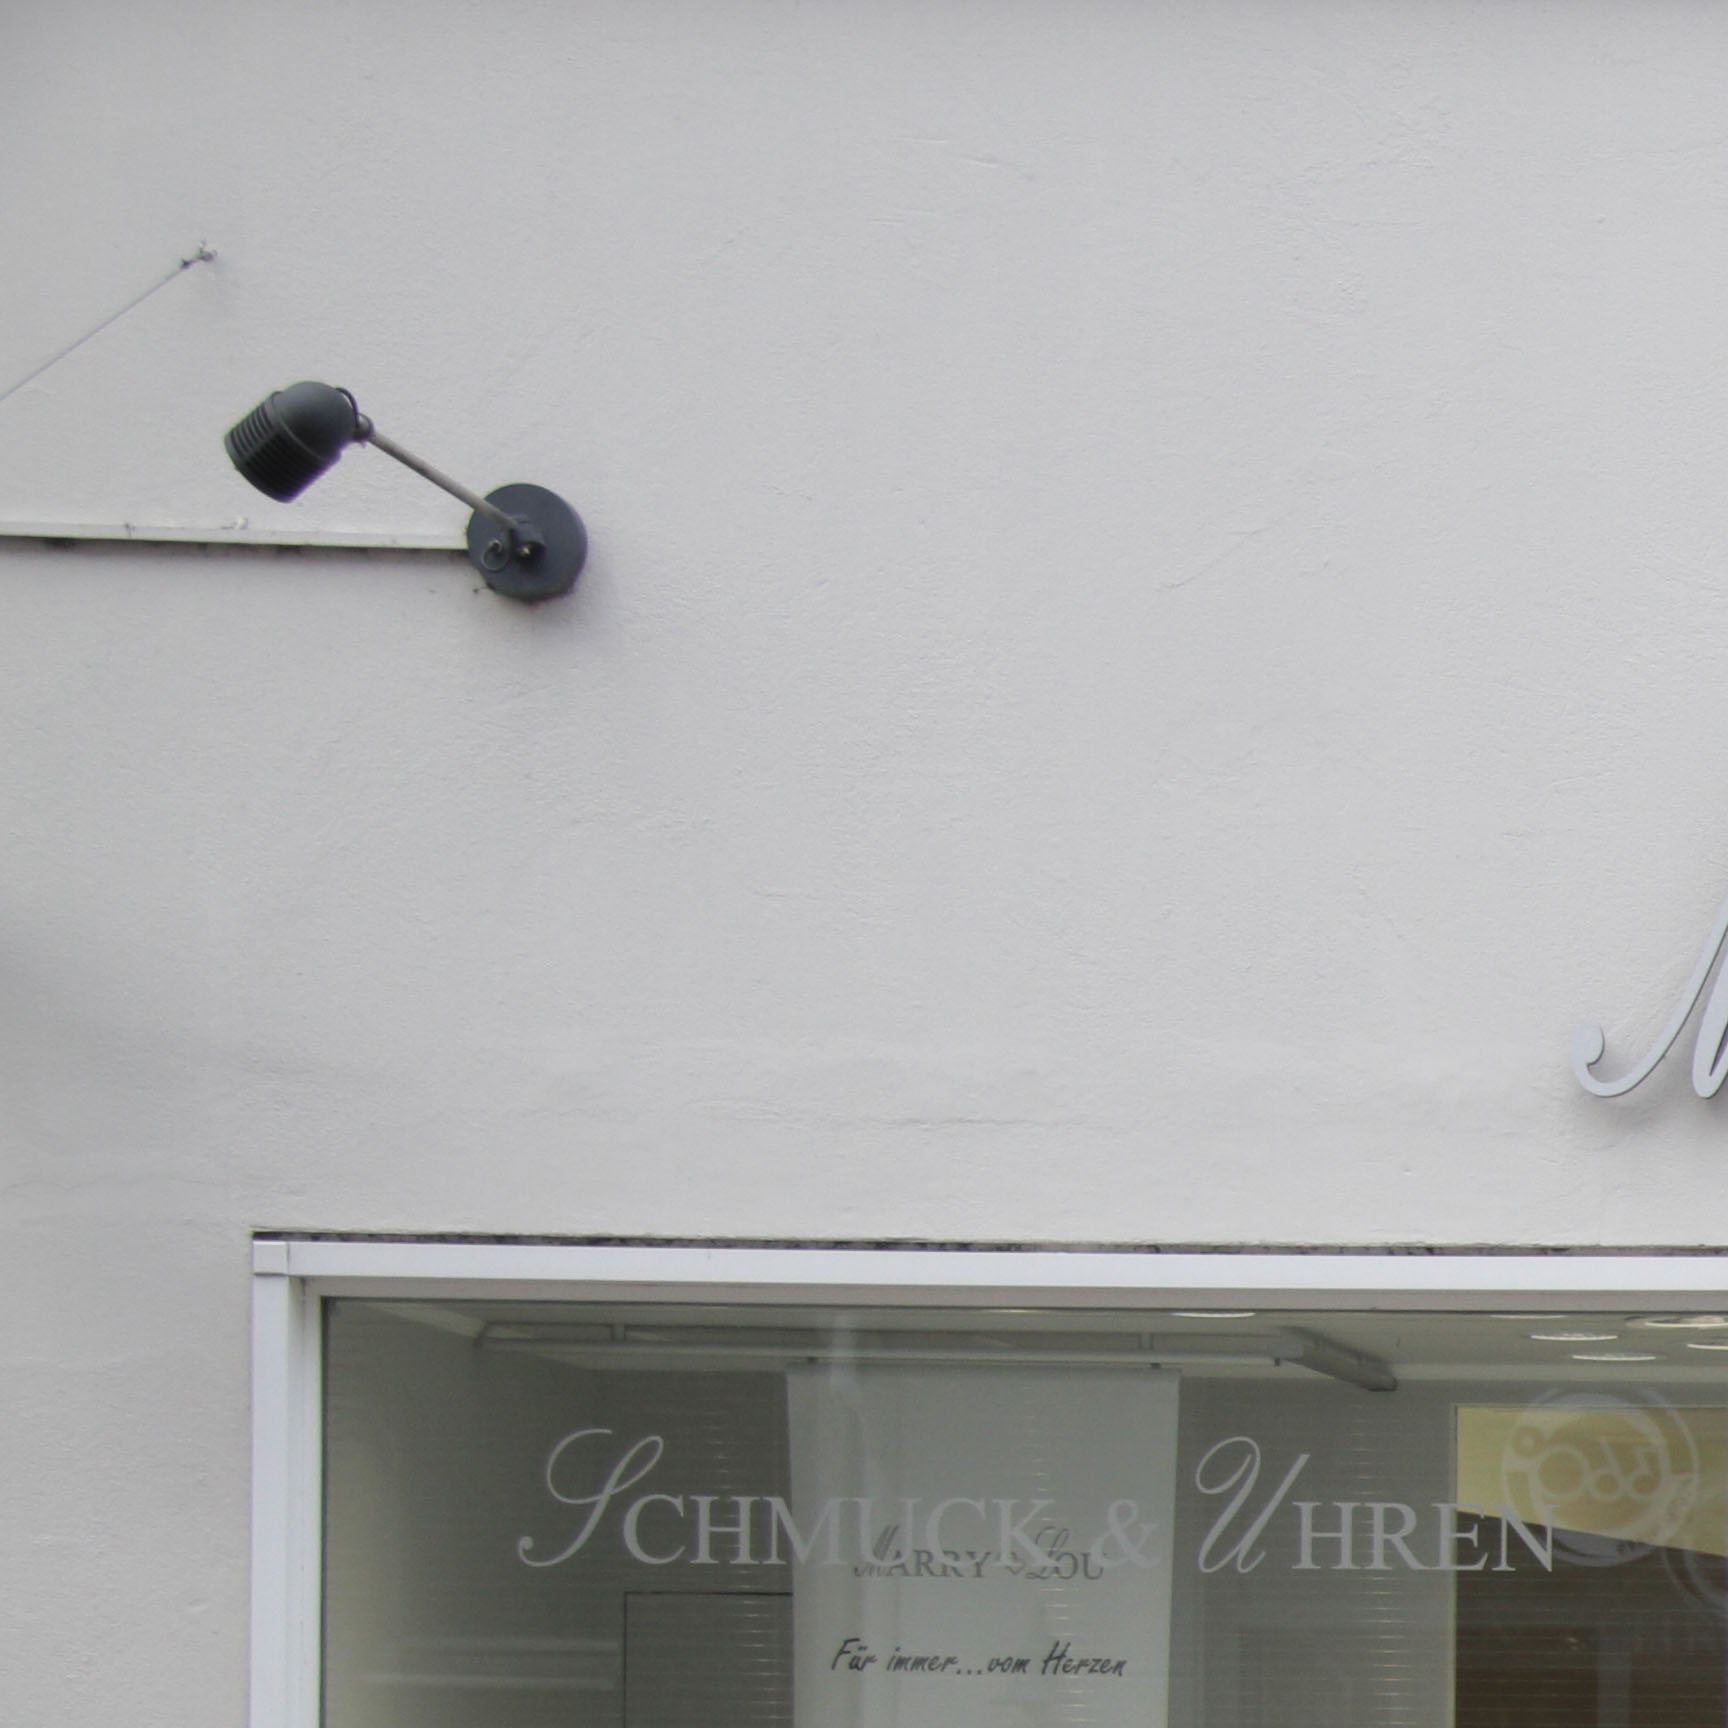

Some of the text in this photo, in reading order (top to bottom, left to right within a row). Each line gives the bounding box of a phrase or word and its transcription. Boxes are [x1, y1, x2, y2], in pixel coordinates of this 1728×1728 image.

[519, 1429, 1556, 1575] SCHMUCK & UHREN
[831, 1638, 878, 1672] Für
[1041, 1640, 1128, 1677] Herzen
